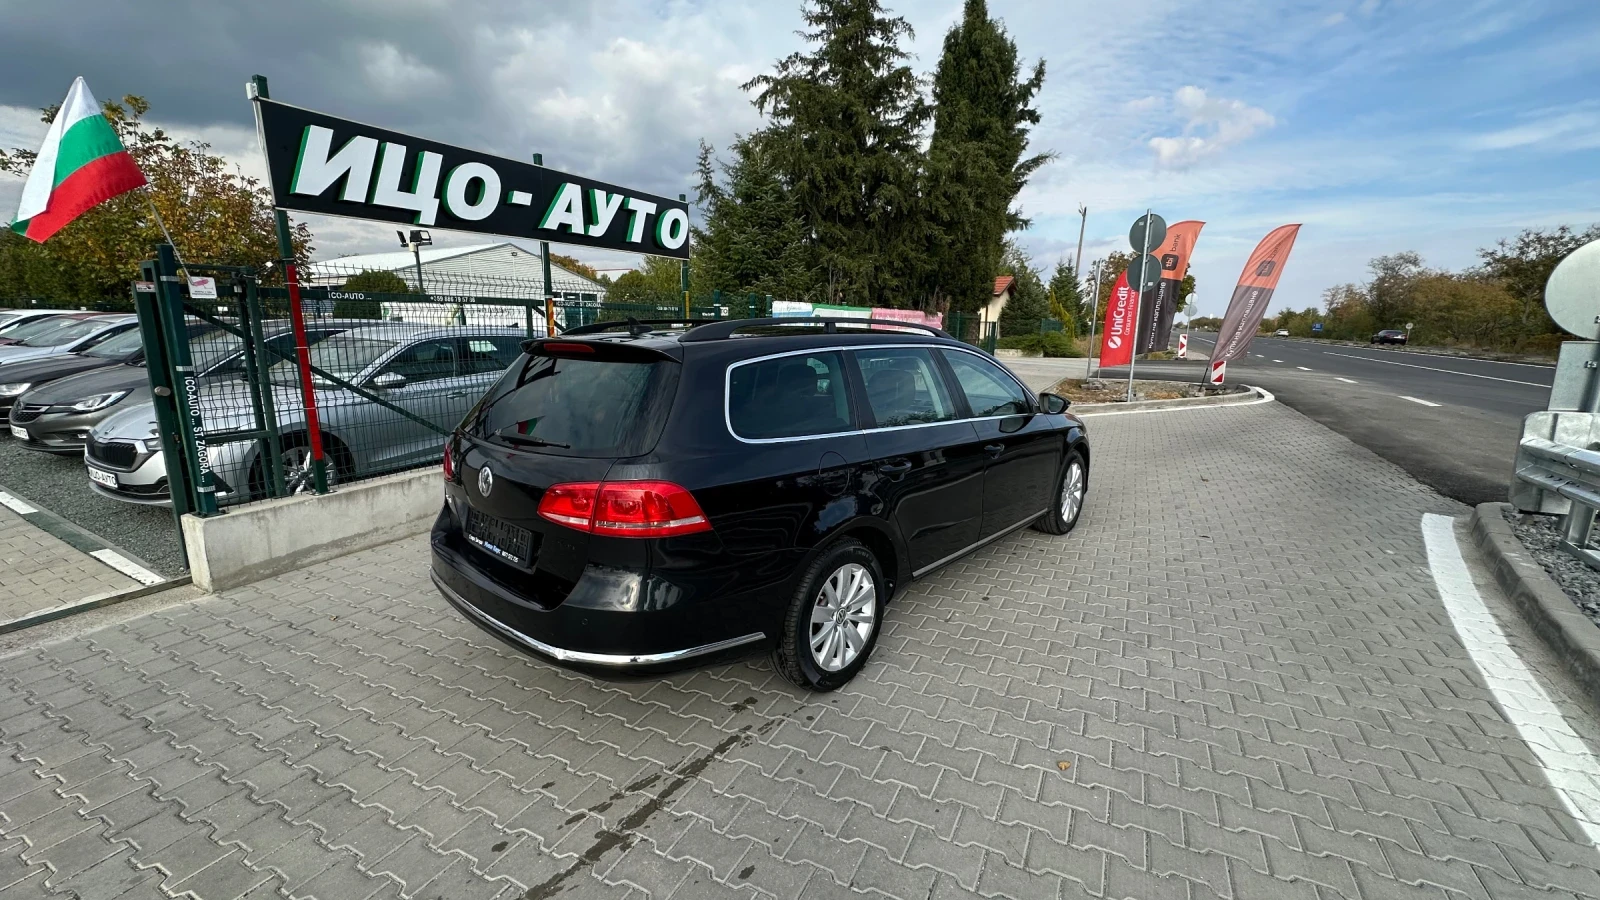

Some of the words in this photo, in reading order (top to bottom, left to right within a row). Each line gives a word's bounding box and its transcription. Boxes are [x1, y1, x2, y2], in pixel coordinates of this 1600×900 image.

[1170, 234, 1182, 252] bank
[1110, 286, 1130, 336] UniCredit
[193, 426, 204, 439] ST.
[196, 440, 210, 475] ZAGORA
